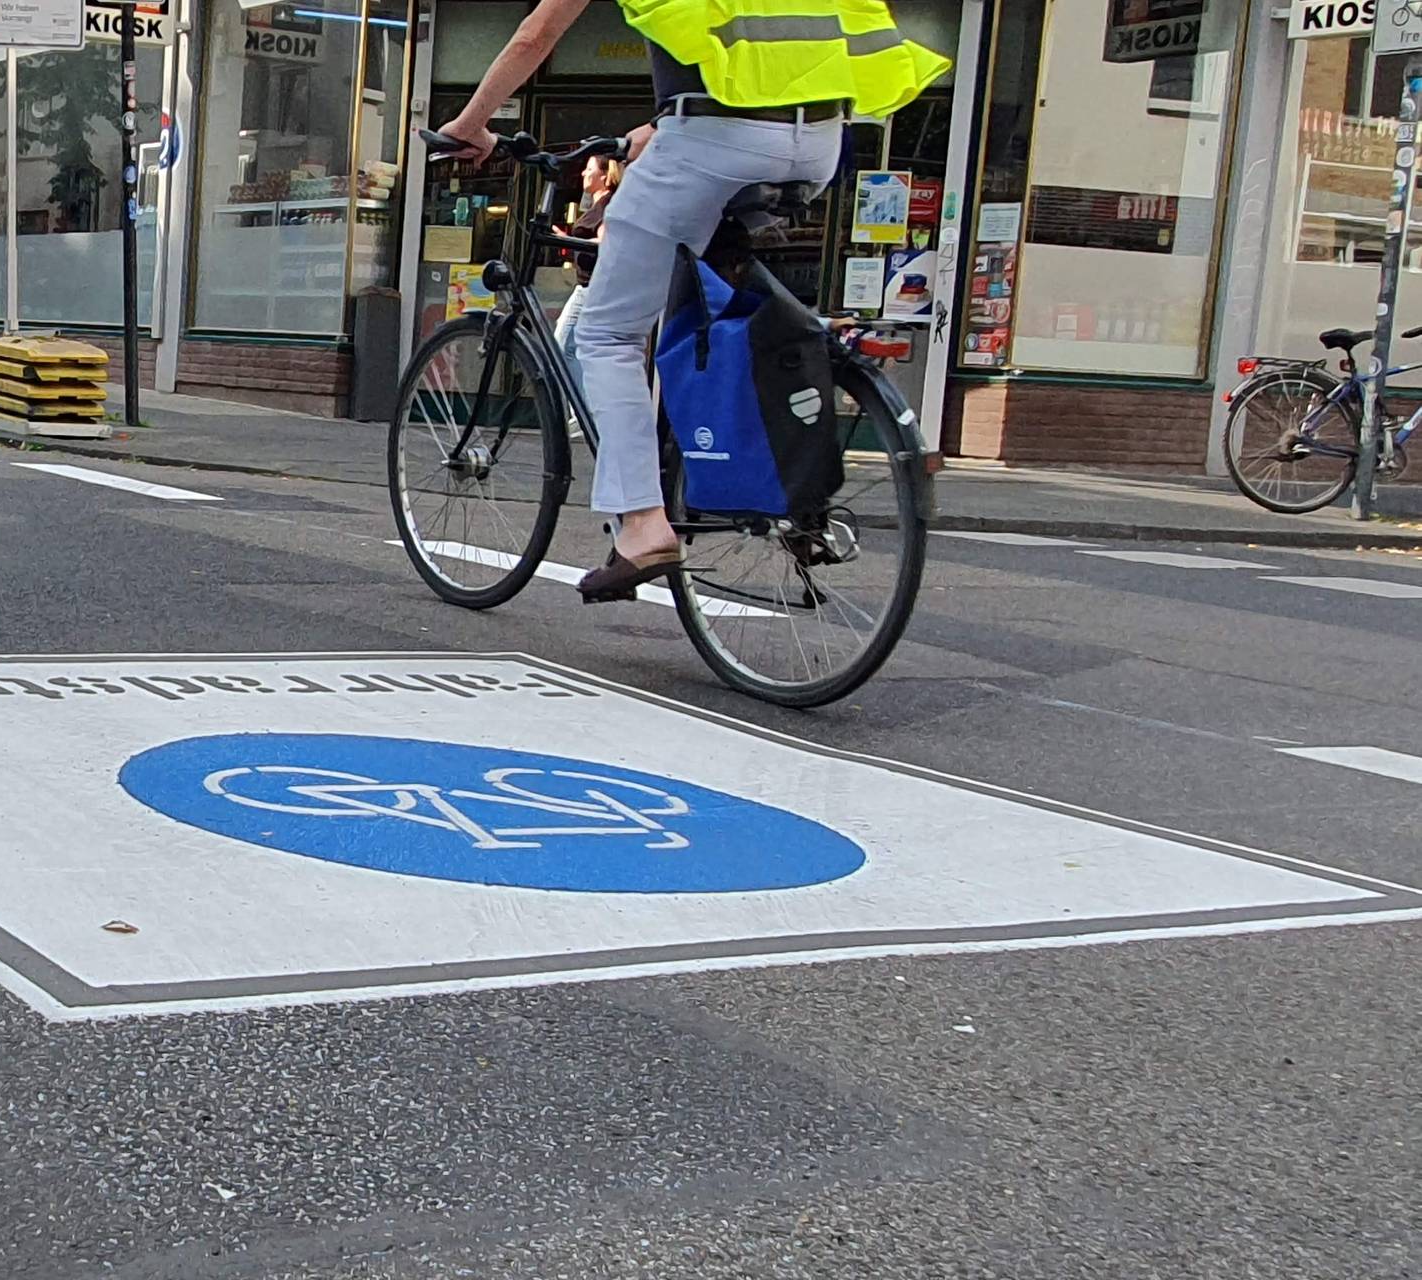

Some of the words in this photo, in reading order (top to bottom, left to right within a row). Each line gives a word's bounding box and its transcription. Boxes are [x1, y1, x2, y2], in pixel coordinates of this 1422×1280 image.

[85, 11, 163, 39] KIOSK
[1303, 0, 1376, 31] KIOS
[1400, 30, 1421, 43] fre
